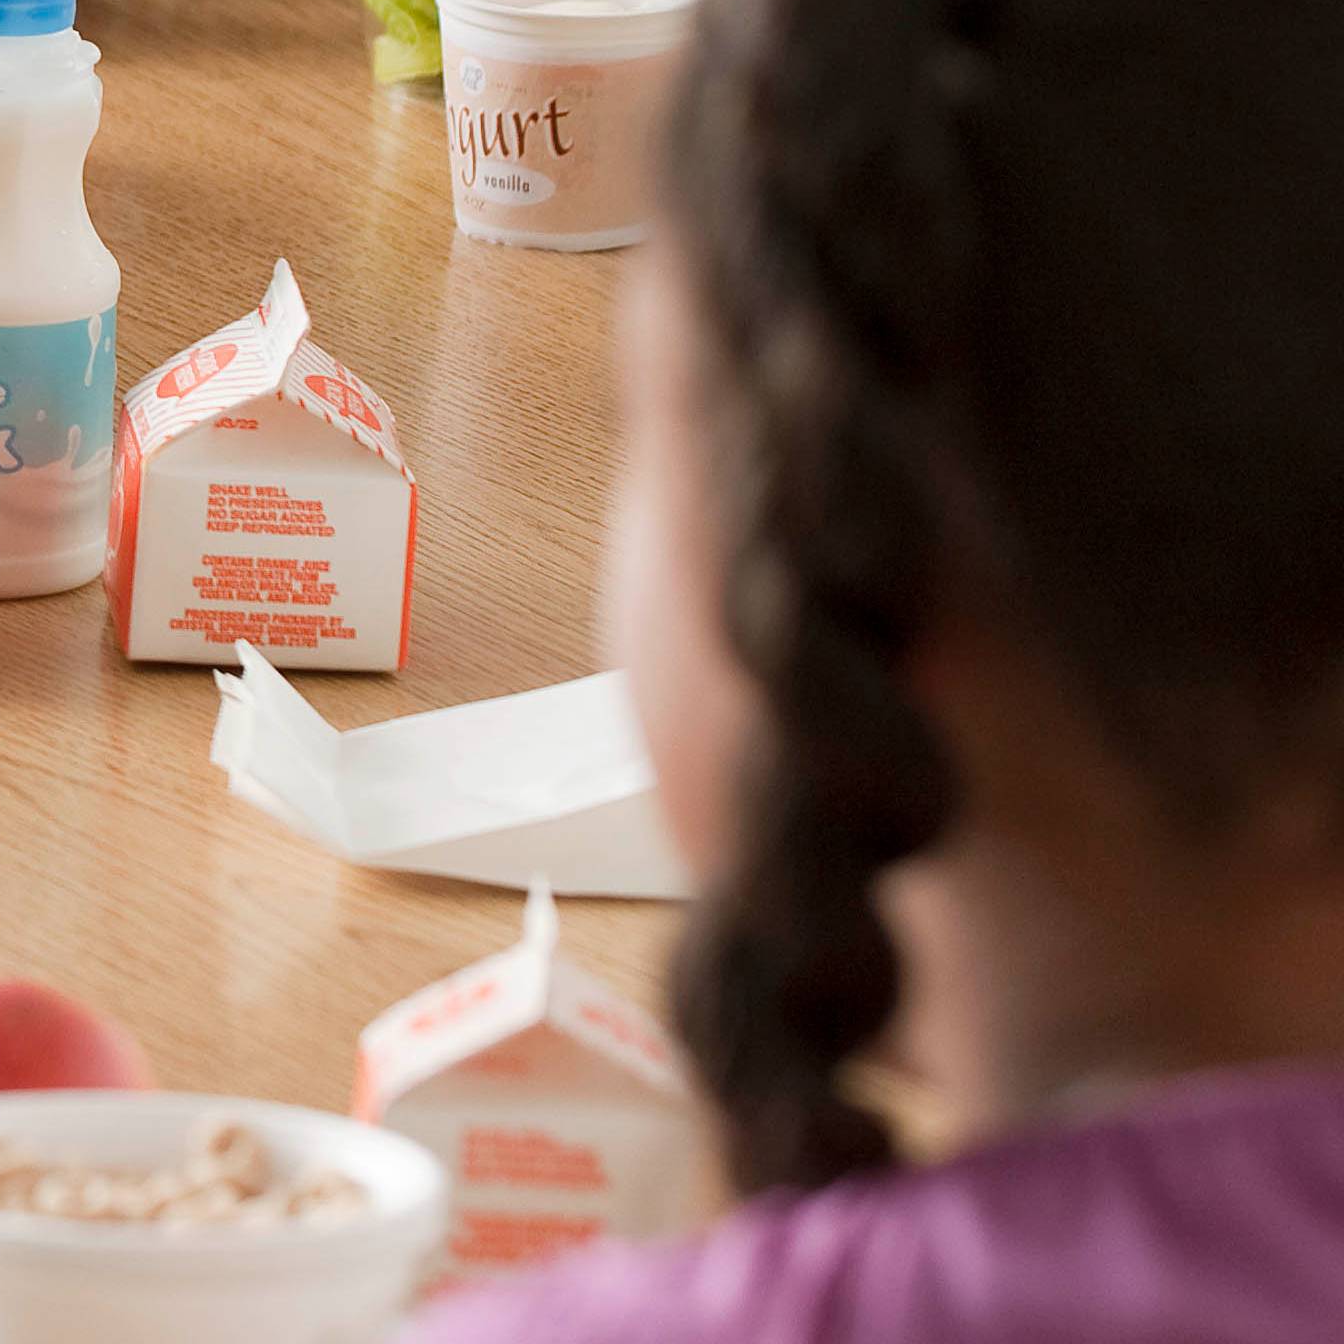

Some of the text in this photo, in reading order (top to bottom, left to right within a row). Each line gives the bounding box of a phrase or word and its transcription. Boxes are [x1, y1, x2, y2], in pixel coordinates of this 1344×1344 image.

[449, 96, 575, 187] gurt
[483, 174, 531, 194] vanilla
[209, 484, 289, 498] SHAKE WELL
[208, 496, 323, 512] NO PRESERVATIVES
[208, 508, 326, 524] NO SUGAR ADDED
[207, 521, 335, 538] KEEP REFRIGERATED
[202, 555, 330, 572] CONTAINS ORANGE JUICE
[192, 577, 213, 588] USA
[212, 567, 320, 582] CONCENTRATE FROM
[200, 588, 233, 600] COSTA
[267, 592, 289, 603] AND
[292, 593, 332, 605] MEXICO
[184, 608, 344, 626] PROCESSED AND PACKAGED BY
[320, 627, 357, 640] WATER
